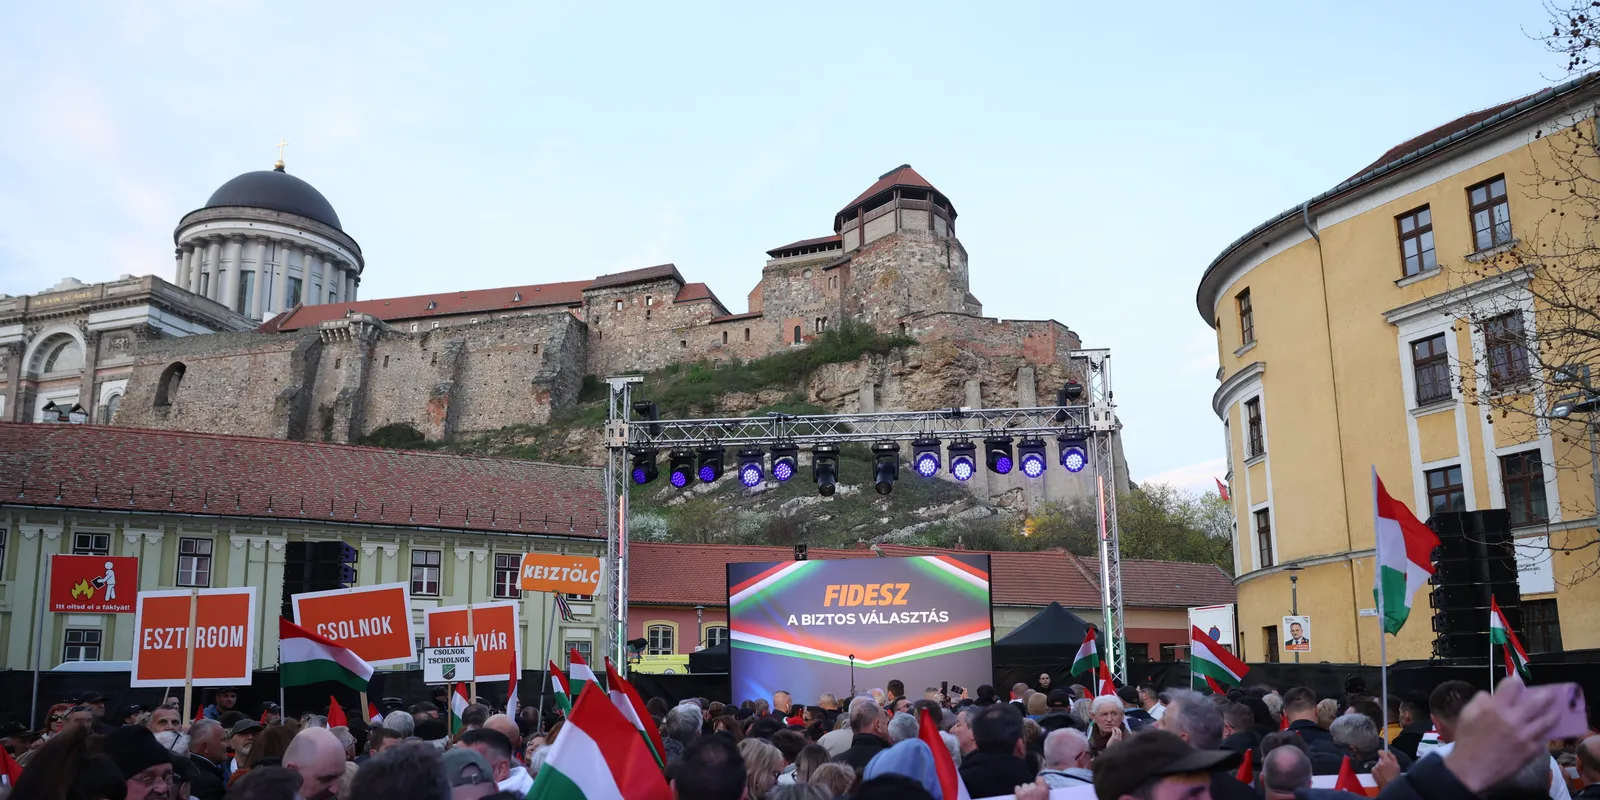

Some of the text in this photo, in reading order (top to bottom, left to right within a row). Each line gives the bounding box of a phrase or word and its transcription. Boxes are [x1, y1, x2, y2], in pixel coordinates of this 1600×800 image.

[523, 563, 600, 584] KESZTÖLC
[823, 583, 911, 607] FIDESZ
[102, 604, 130, 612] fáklyát!
[787, 608, 949, 626] A BIZTOS VÁLASZTÁS
[316, 615, 393, 641] CSOLNOK
[427, 656, 470, 664] TSCHOLNOK
[433, 648, 466, 656] CSOLNOK
